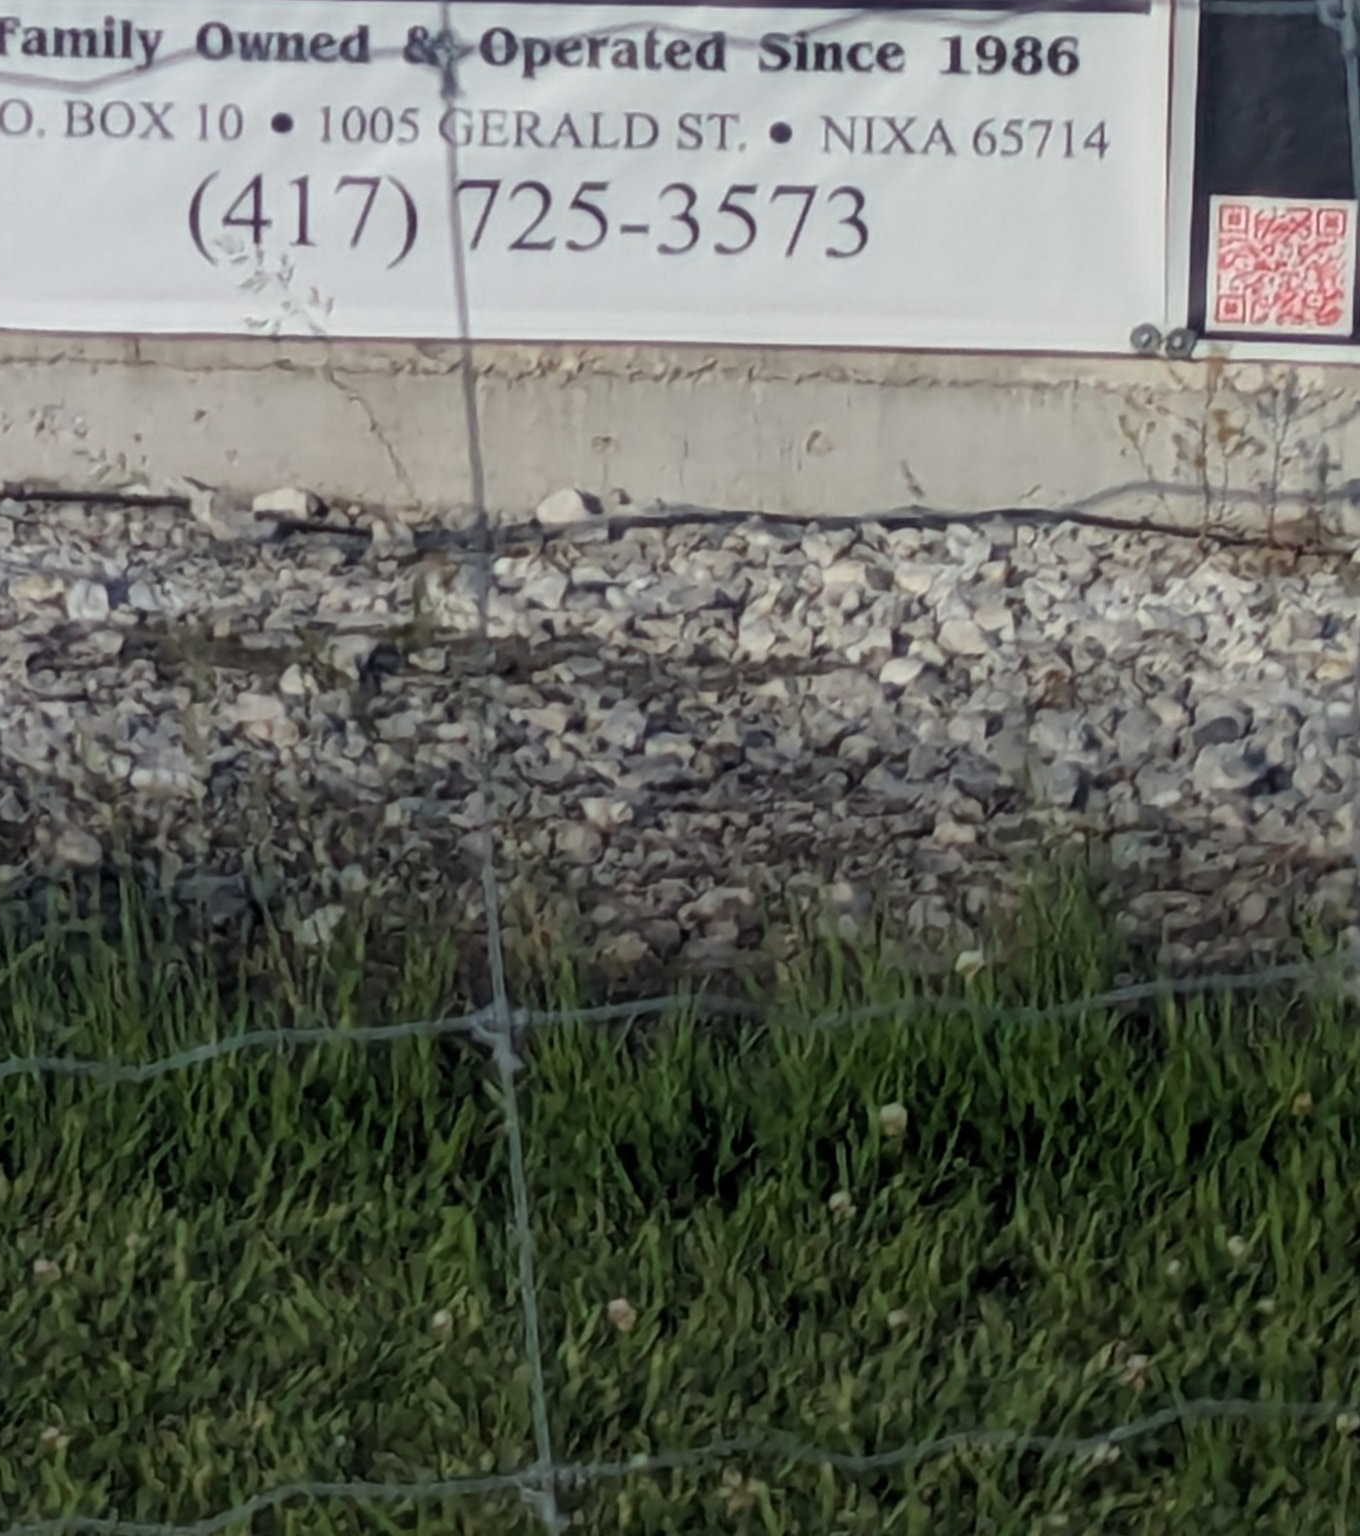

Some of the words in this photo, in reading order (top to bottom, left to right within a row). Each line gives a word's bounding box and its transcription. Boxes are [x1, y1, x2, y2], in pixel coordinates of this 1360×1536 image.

[195, 21, 371, 65] Owned
[479, 25, 728, 80] Operated
[756, 31, 906, 75] Since
[938, 34, 1082, 77] 1986
[63, 100, 175, 141] BOX
[195, 102, 245, 143] 10
[317, 104, 420, 145] 1005
[438, 107, 659, 150] GERALD
[676, 112, 748, 153] ST.
[820, 115, 957, 158] NIXA
[972, 118, 1112, 161] 65714
[188, 170, 418, 269] (417)
[453, 177, 870, 260] 725-3573
